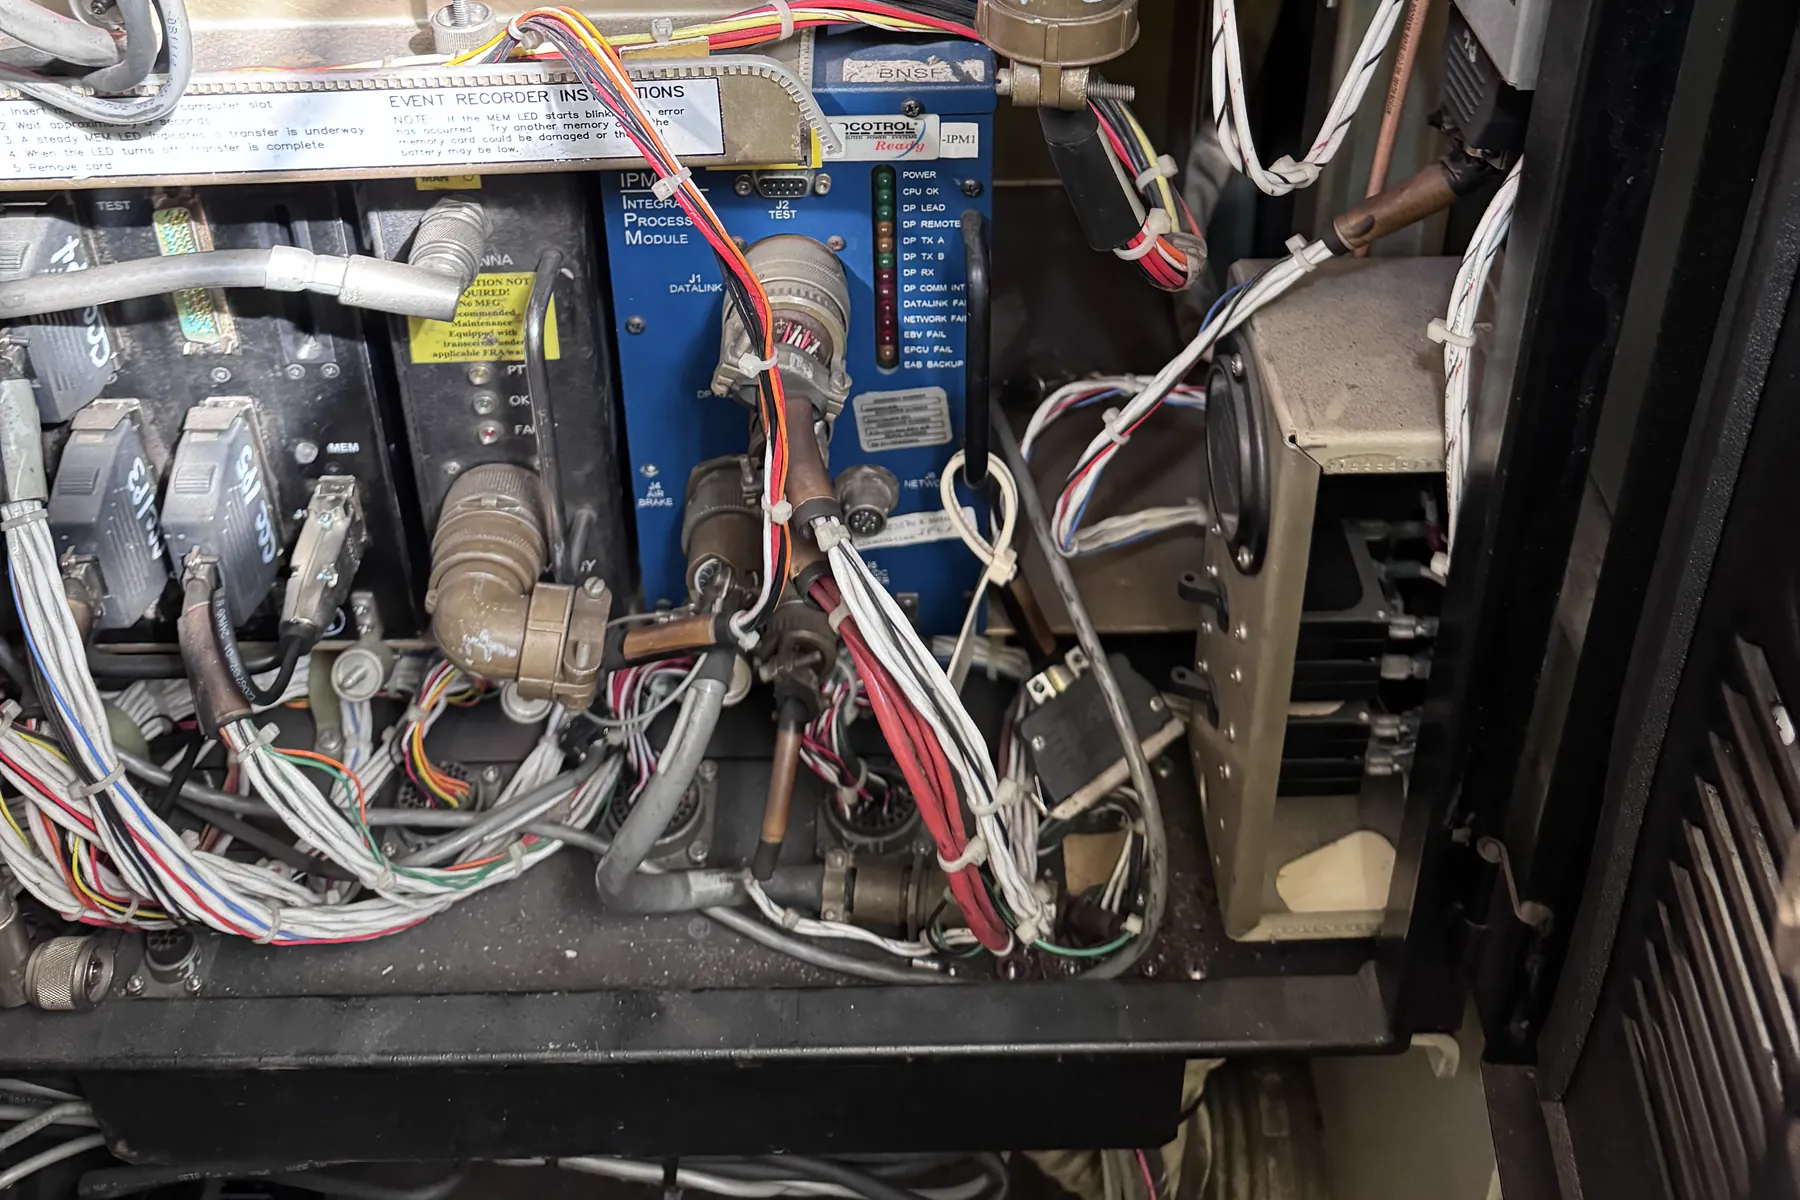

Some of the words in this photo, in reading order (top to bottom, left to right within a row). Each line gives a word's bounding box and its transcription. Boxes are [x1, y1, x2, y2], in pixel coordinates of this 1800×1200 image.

[879, 68, 943, 79] BNSF
[389, 94, 445, 108] EVENT
[456, 90, 550, 106] RECORDER
[249, 100, 273, 109] slot
[11, 107, 49, 116] Insert
[462, 114, 481, 122] the
[487, 113, 511, 121] MEM
[517, 112, 538, 121] LED
[545, 109, 580, 120] starts
[658, 107, 685, 116] error
[16, 121, 41, 131] Wait
[491, 123, 507, 133] Try
[513, 123, 557, 132] another
[563, 121, 609, 132] memory
[37, 136, 78, 146] steady
[85, 132, 112, 142] MEM
[119, 131, 142, 142] LED
[229, 127, 280, 139] transfer
[286, 126, 298, 137] is
[304, 126, 366, 137] underway
[451, 136, 476, 145] card
[482, 135, 512, 144] could
[519, 134, 532, 142] be
[539, 132, 590, 143] damaged
[596, 132, 608, 140] or
[941, 135, 976, 145] -IPM1
[64, 147, 84, 157] the
[91, 147, 114, 157] LED
[122, 145, 155, 156] turns
[249, 141, 260, 152] is
[266, 139, 325, 153] complete
[448, 148, 473, 156] may
[478, 146, 492, 154] be
[875, 140, 925, 153] Ready
[29, 162, 78, 172] Remove
[86, 161, 113, 171] card
[903, 171, 937, 179] POWER
[620, 172, 656, 188] IPM
[903, 188, 922, 196] CPU
[926, 187, 940, 195] OK
[96, 201, 131, 211] TEST
[775, 200, 789, 209] J2
[903, 204, 917, 212] DP
[921, 204, 946, 212] LEAD
[768, 210, 797, 220] TEST
[903, 220, 917, 228] DP
[920, 220, 961, 228] REMOTE
[625, 230, 689, 245] MODULE
[903, 237, 917, 245] DP
[921, 236, 934, 244] TX
[937, 236, 945, 244] A
[903, 253, 917, 261] DP
[903, 269, 917, 277] DP
[506, 277, 531, 286] NOT
[688, 274, 701, 284] J1
[669, 284, 723, 294] DATALINK
[903, 284, 917, 293] DP
[920, 284, 947, 292] COMM
[475, 299, 501, 307] MFG
[904, 300, 949, 308] DATALINK
[452, 319, 513, 327] Maintenance
[904, 316, 948, 324] NETWORK
[498, 329, 517, 337] with
[904, 331, 923, 339] EBV
[926, 331, 946, 339] FAIL
[433, 350, 480, 359] applicable
[904, 346, 930, 354] EPCU
[927, 360, 964, 368] BACKUP
[509, 395, 530, 405] OK
[328, 443, 359, 453] MEM
[648, 481, 661, 490] J4
[646, 489, 665, 498] AIR
[637, 498, 674, 507] BRAKE
